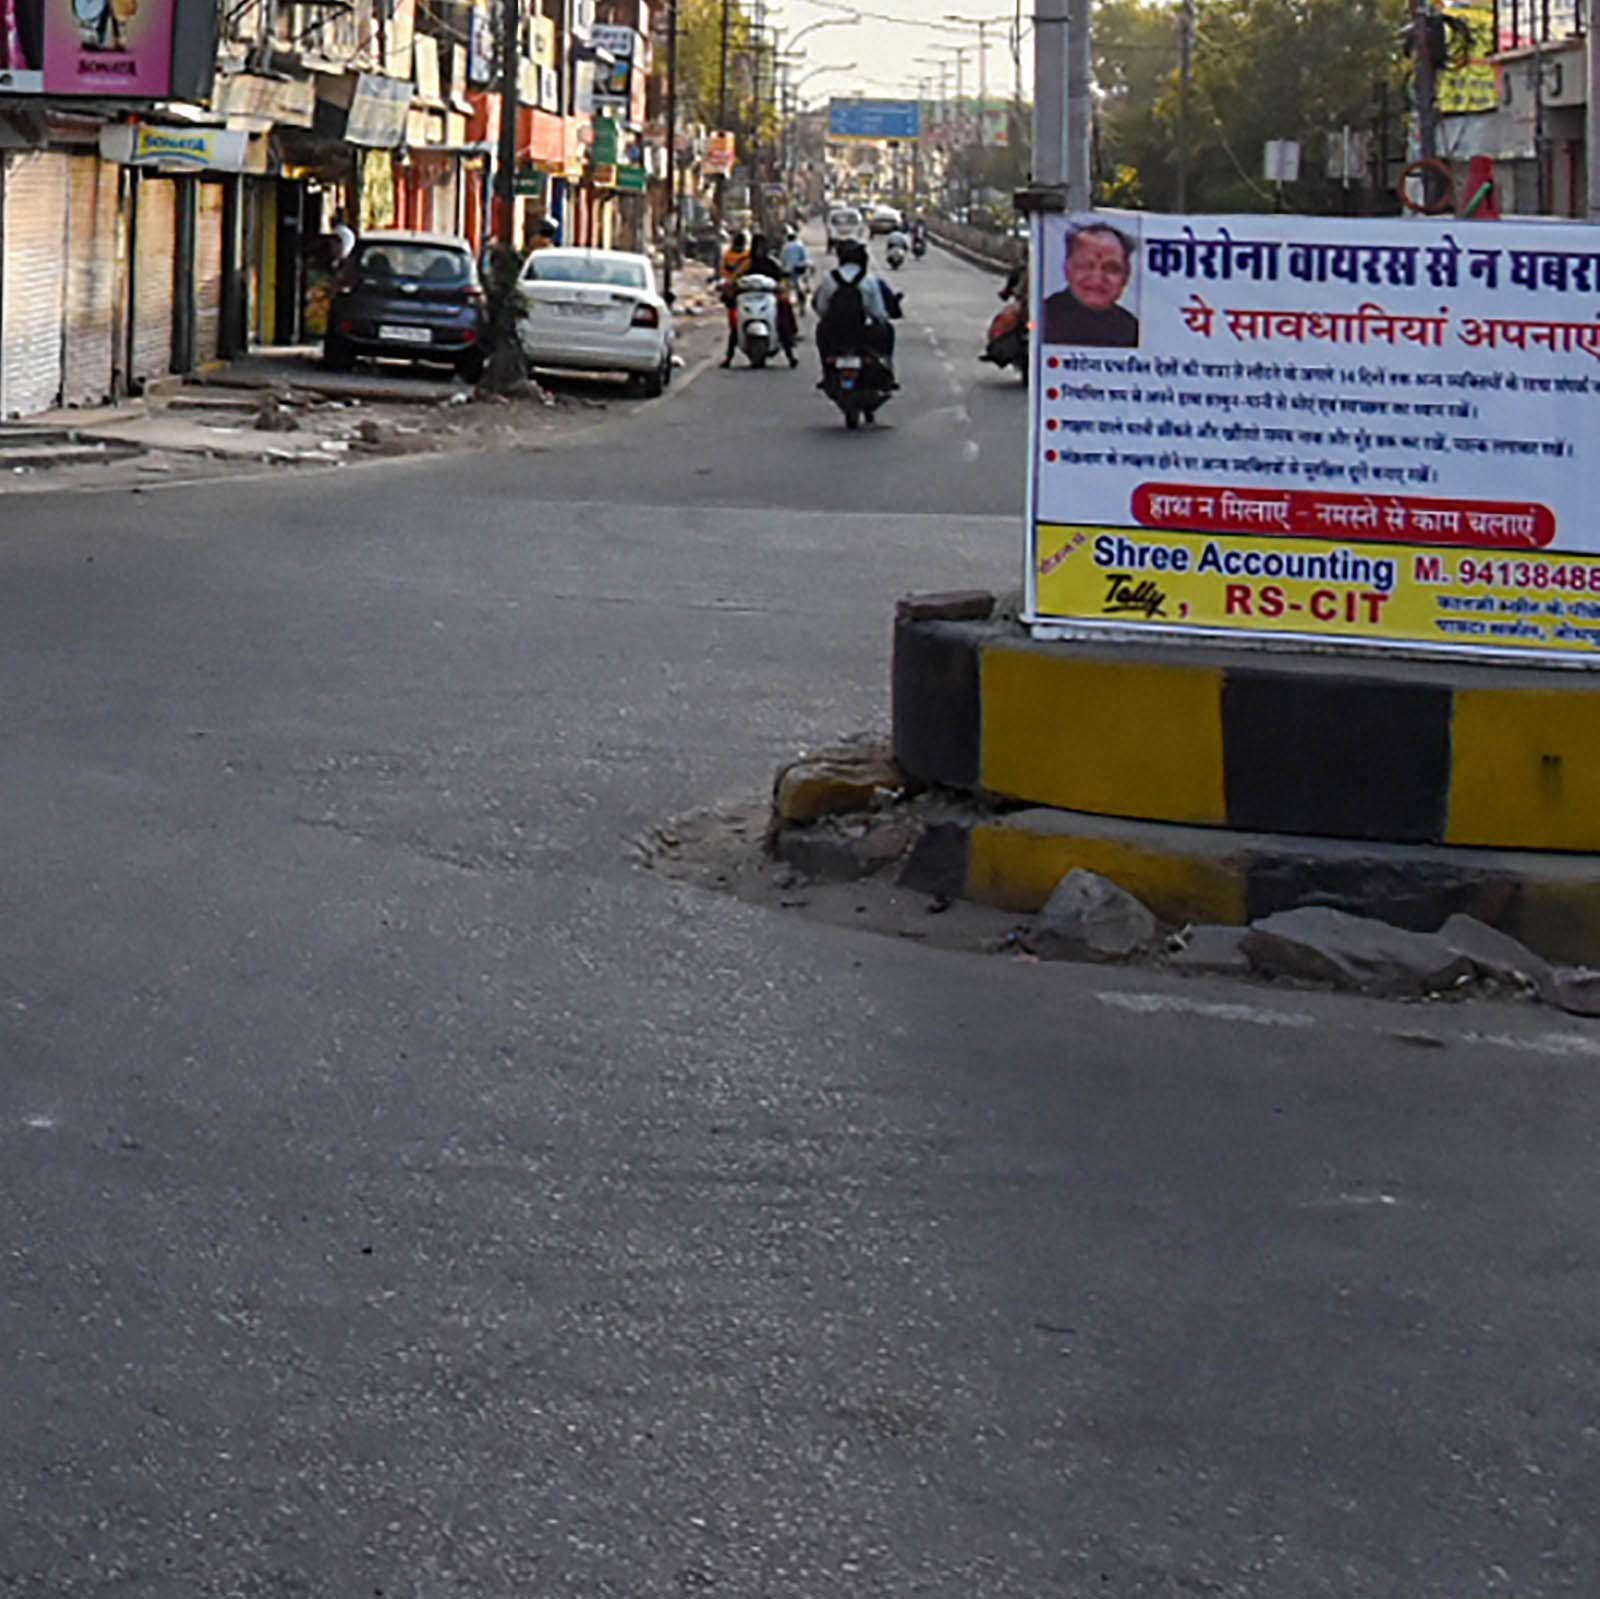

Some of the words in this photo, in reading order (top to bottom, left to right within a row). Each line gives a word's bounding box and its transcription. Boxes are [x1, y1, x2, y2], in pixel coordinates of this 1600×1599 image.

[1146, 226, 1282, 280] कोरोना
[1287, 243, 1420, 286] वायरस
[1426, 234, 1461, 287] से
[1468, 249, 1502, 289] न
[1180, 294, 1214, 339] ये
[1223, 302, 1449, 347] सावधानियां
[1149, 493, 1191, 519] हाथ
[1197, 497, 1214, 519] न
[1221, 492, 1291, 530] मिलाएं
[1314, 498, 1379, 529] नमस्ते
[1384, 497, 1402, 531] से
[1411, 506, 1460, 534] काम
[1467, 508, 1538, 546] चलाएं
[1093, 535, 1189, 572] Shree
[1197, 542, 1395, 591] Accounting
[1415, 555, 1450, 583] M.
[1225, 583, 1390, 625] RS-CIT
